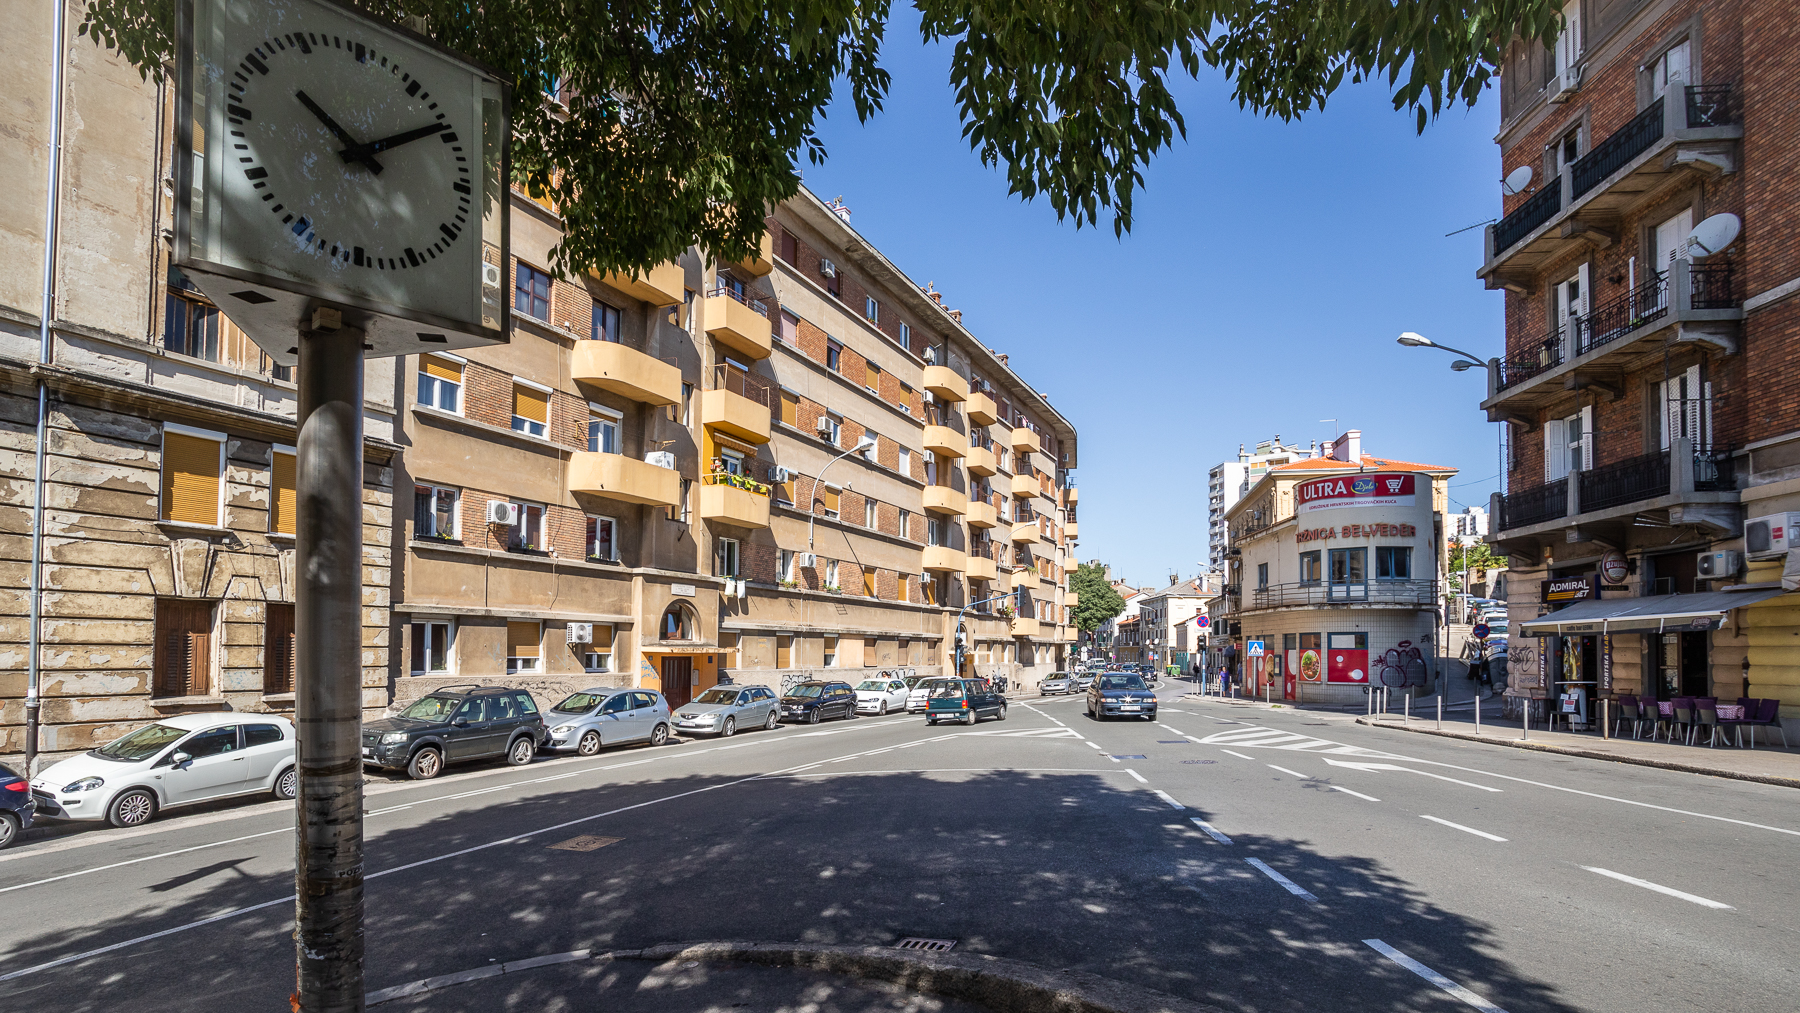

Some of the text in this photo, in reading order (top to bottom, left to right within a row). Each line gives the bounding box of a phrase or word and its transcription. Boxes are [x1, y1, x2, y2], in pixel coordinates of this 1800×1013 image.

[1304, 480, 1347, 500] ULTRA
[1341, 524, 1416, 538] BELVEDER
[1549, 579, 1590, 593] ADMIRAL
[1574, 589, 1590, 598] BET
